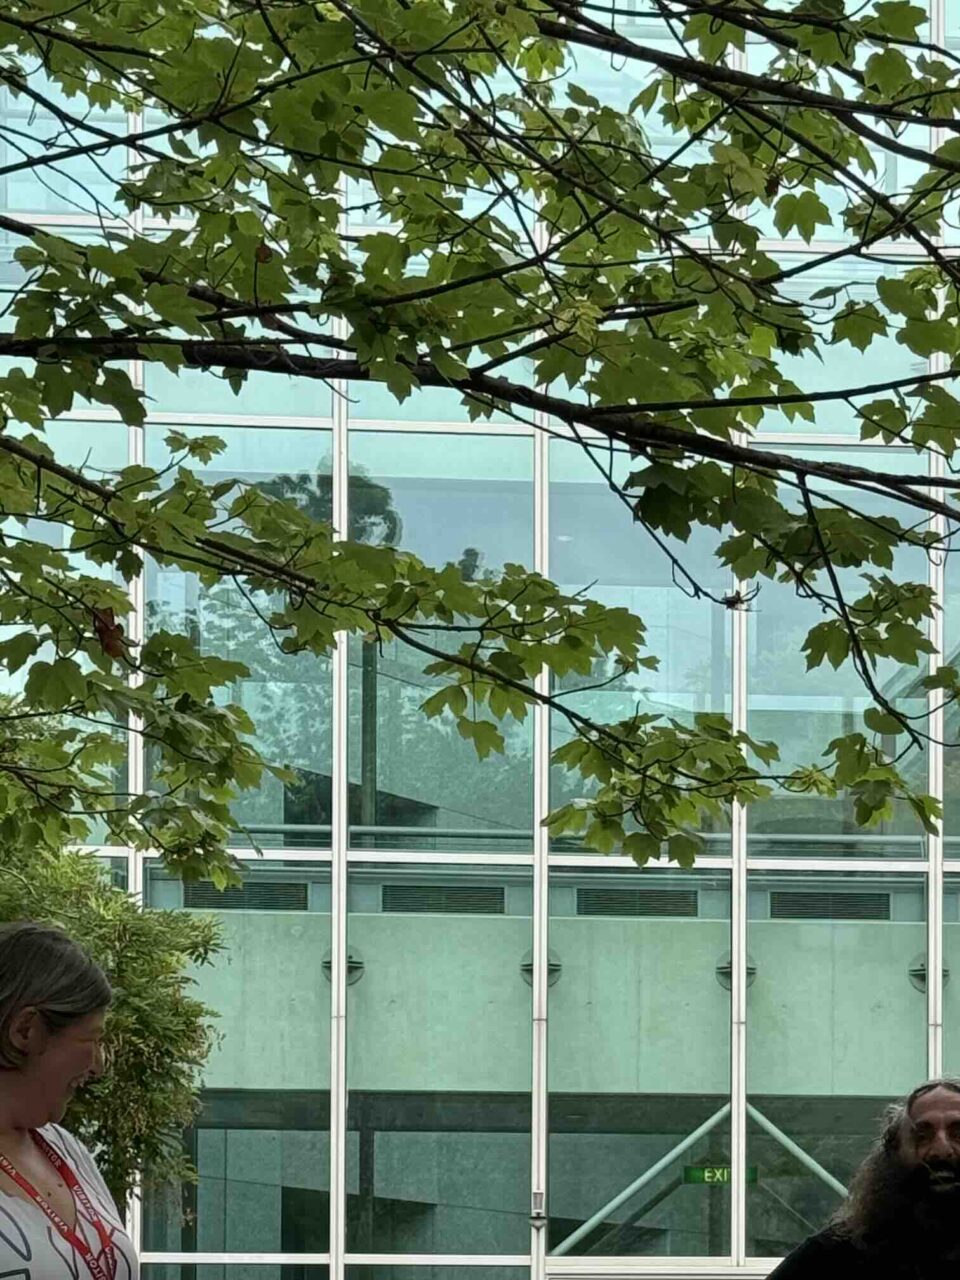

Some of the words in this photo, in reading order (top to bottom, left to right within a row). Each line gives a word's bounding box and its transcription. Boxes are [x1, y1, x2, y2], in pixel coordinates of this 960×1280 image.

[704, 1167, 731, 1182] EXI
[36, 1196, 68, 1232] VISITOR
[72, 1184, 98, 1222] VISITOR
